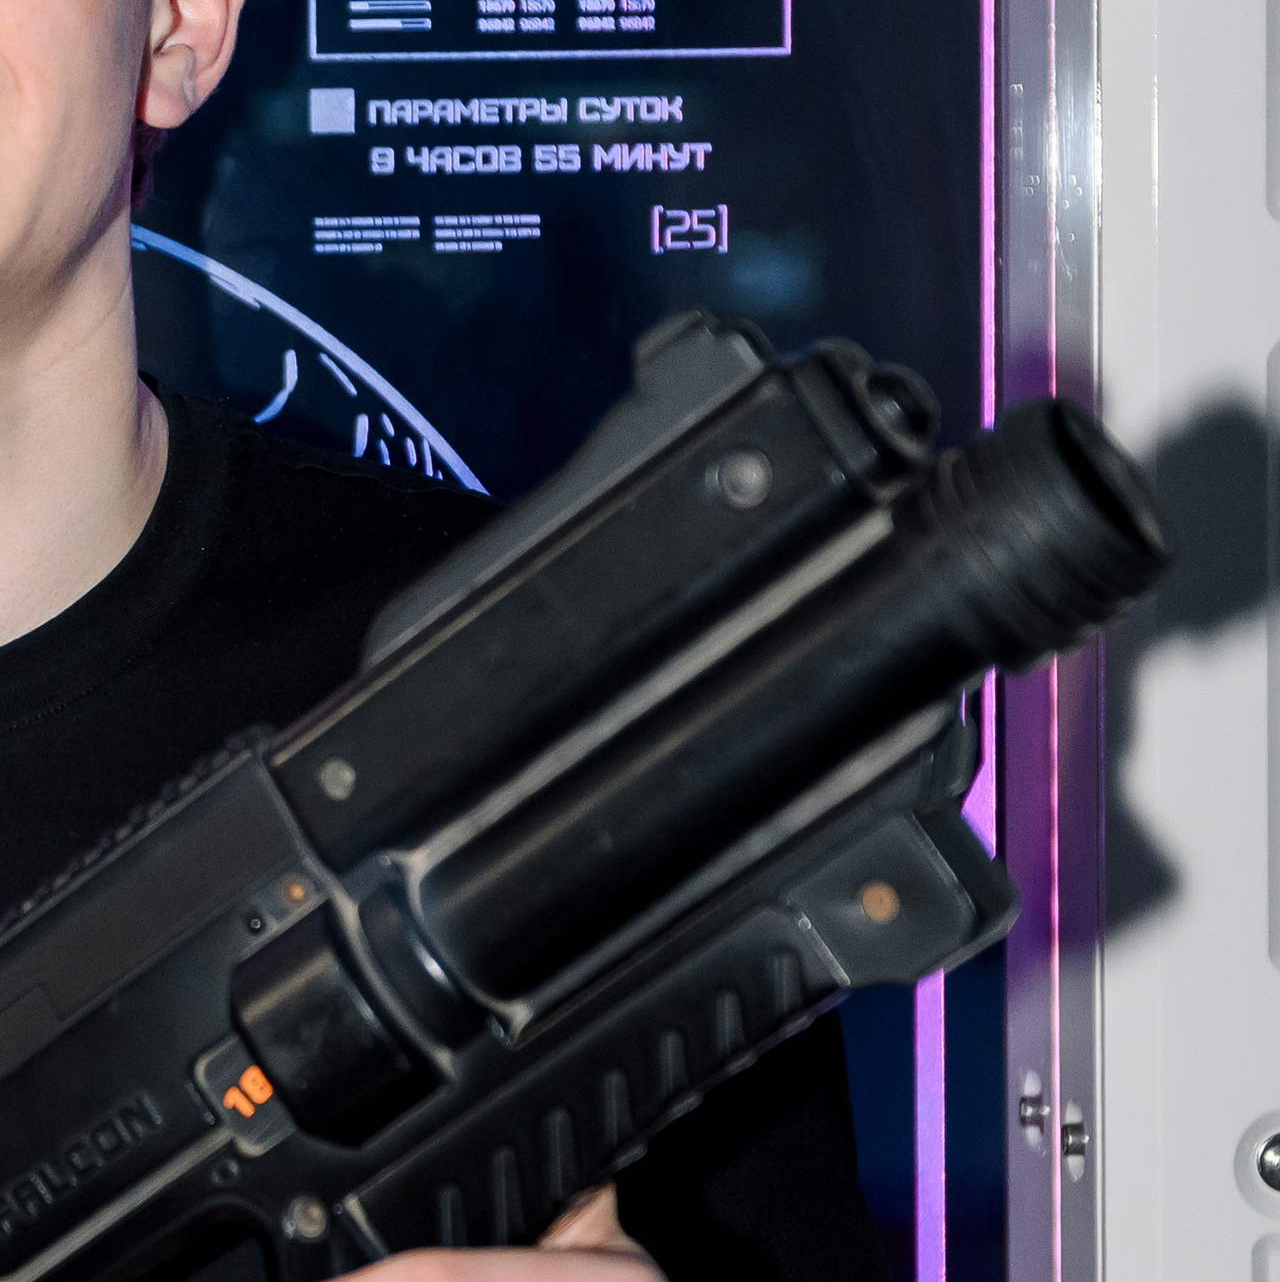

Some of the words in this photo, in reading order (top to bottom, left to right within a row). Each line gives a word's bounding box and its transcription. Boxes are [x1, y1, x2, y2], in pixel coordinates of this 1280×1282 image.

[368, 97, 568, 126] ПАРАМЕТРЫ
[578, 95, 683, 124] СУТОК
[406, 144, 522, 175] ЧАСОВ
[533, 144, 581, 173] 55
[592, 142, 712, 173] МИНУТ
[650, 204, 728, 254] [25]
[223, 1064, 274, 1119] 18
